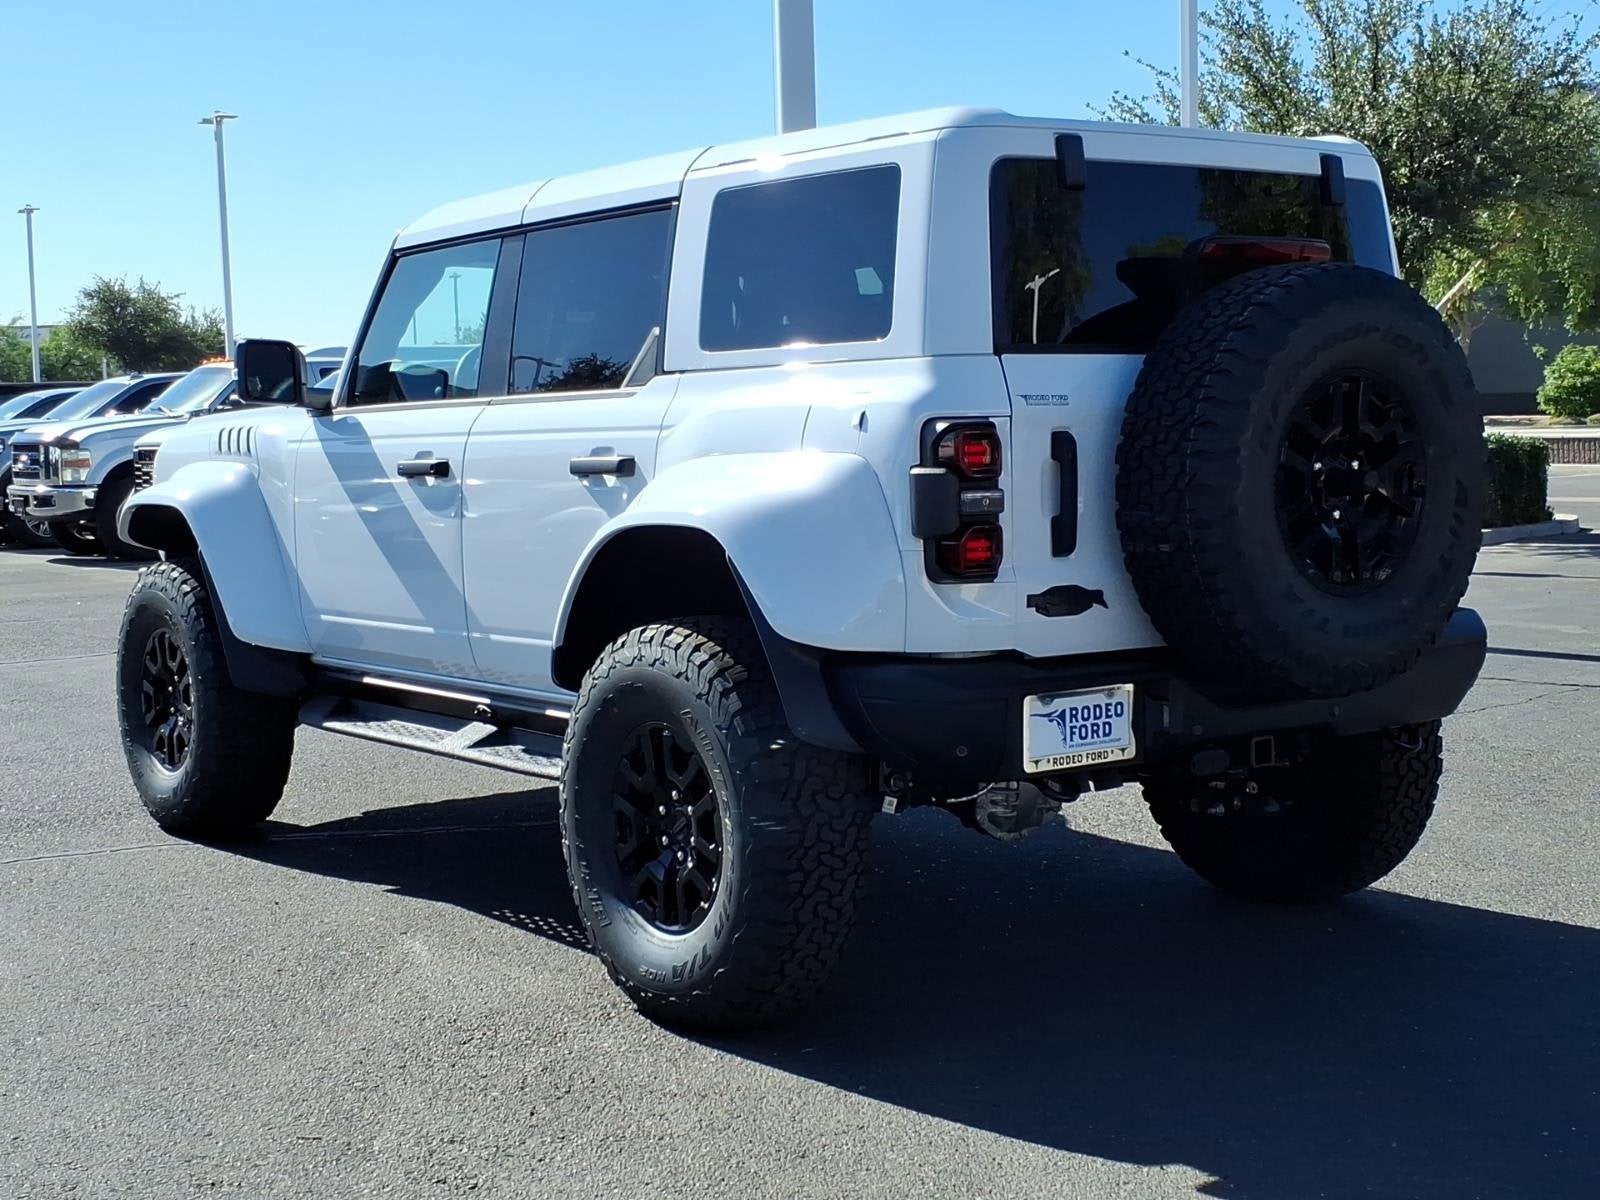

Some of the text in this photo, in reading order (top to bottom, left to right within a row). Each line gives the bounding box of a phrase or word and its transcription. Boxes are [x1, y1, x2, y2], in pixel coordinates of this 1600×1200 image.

[1069, 701, 1124, 724] RODEO
[1069, 721, 1112, 742] FORD
[1052, 750, 1109, 767] RODEO FORD
